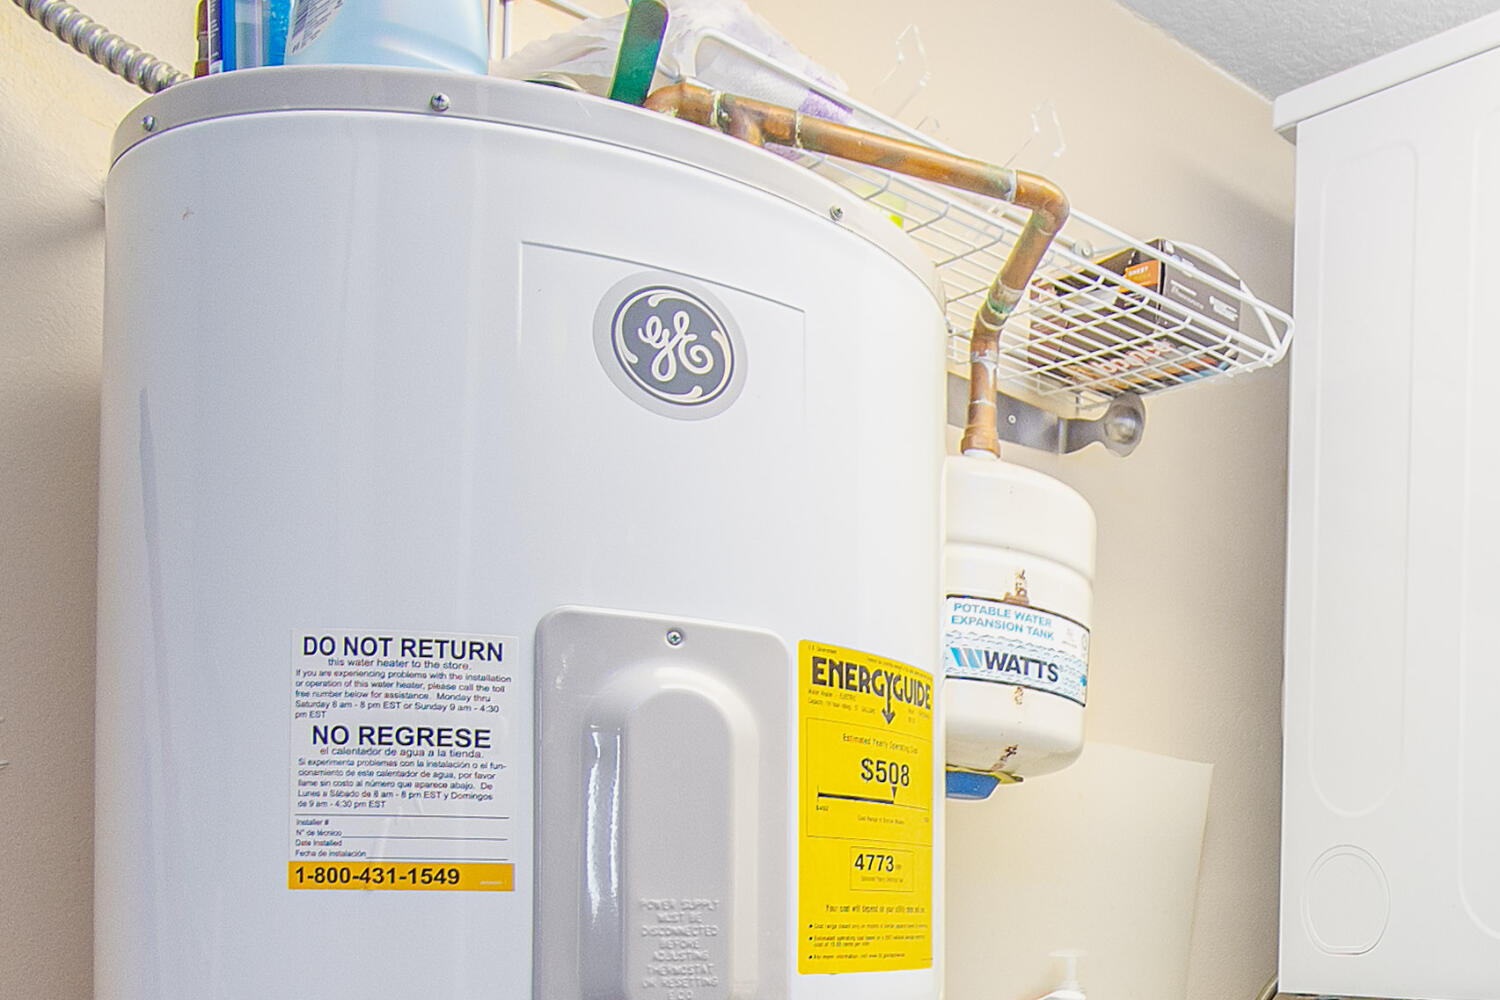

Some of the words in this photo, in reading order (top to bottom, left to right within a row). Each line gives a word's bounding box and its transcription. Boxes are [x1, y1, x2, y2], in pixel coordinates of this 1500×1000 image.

[953, 602, 1011, 618] POTABLE
[1015, 610, 1052, 627] WATER
[951, 615, 1023, 632] EXPANSION
[1028, 625, 1054, 640] TANK
[304, 636, 335, 656] DO
[344, 637, 393, 656] NOT
[401, 638, 502, 661] RETURN
[377, 659, 409, 668] heater
[443, 662, 472, 670] store.
[984, 650, 1059, 682] WATTS
[334, 671, 385, 679] experiencing
[388, 671, 427, 679] problems
[466, 674, 511, 682] installation
[428, 682, 456, 690] please
[476, 684, 489, 692] the
[812, 656, 931, 710] ENERGYGUIDE
[437, 693, 471, 702] Monday
[295, 701, 329, 709] Saturday
[368, 702, 380, 710] pm
[383, 701, 402, 709] EST
[415, 702, 447, 712] Sunday
[295, 711, 307, 719] pm
[313, 725, 349, 745] NO
[359, 726, 490, 748] REGRESE
[331, 747, 382, 755] calentador
[399, 750, 424, 758] agua
[450, 750, 484, 758] tienda.
[376, 770, 418, 778] calentador
[860, 758, 910, 787] $508
[481, 782, 493, 790] De
[424, 791, 442, 799] EST
[451, 792, 493, 801] Domingos
[354, 801, 366, 809] pm
[368, 800, 386, 808] EST
[854, 853, 894, 872] 4773
[296, 866, 460, 884] 1-800-431-1549
